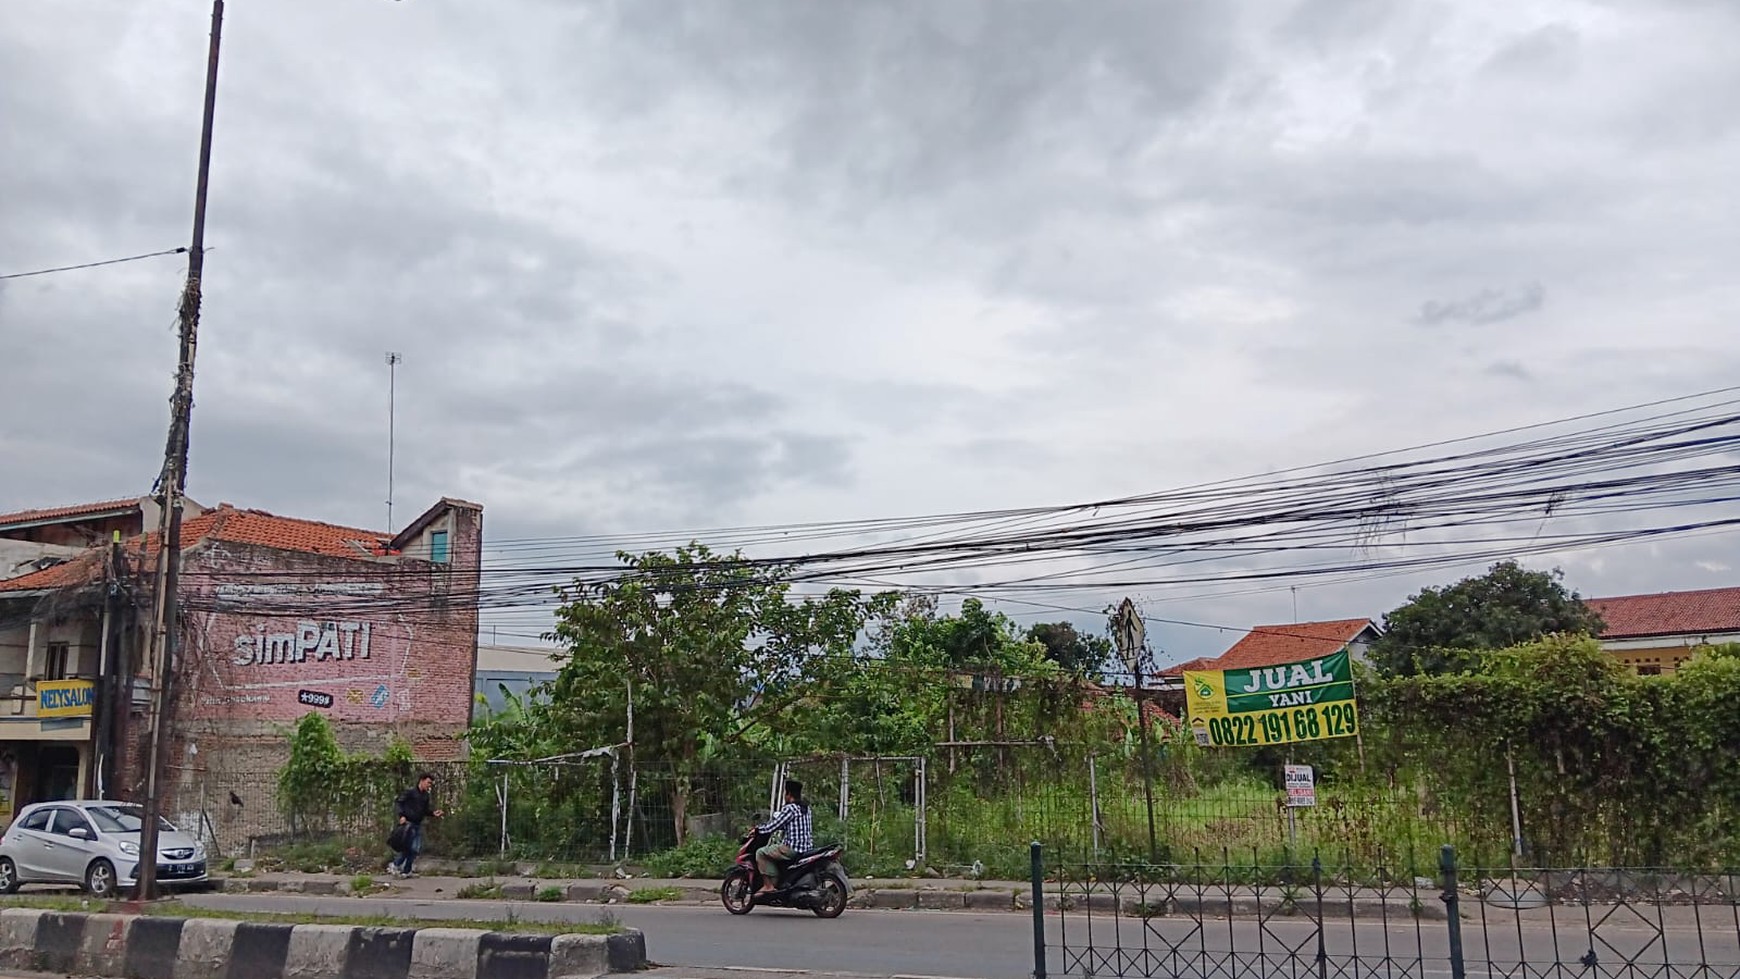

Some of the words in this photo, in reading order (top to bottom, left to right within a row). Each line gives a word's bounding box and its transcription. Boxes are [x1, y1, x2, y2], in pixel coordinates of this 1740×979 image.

[233, 621, 372, 666] simPATI
[1244, 660, 1333, 693] JUAL
[1269, 690, 1313, 708] YANI
[1209, 715, 1258, 746] 0822
[1259, 711, 1292, 743] 191
[1294, 708, 1320, 739] 68
[1322, 703, 1356, 736] 129
[1286, 773, 1311, 782] DIJUAL
